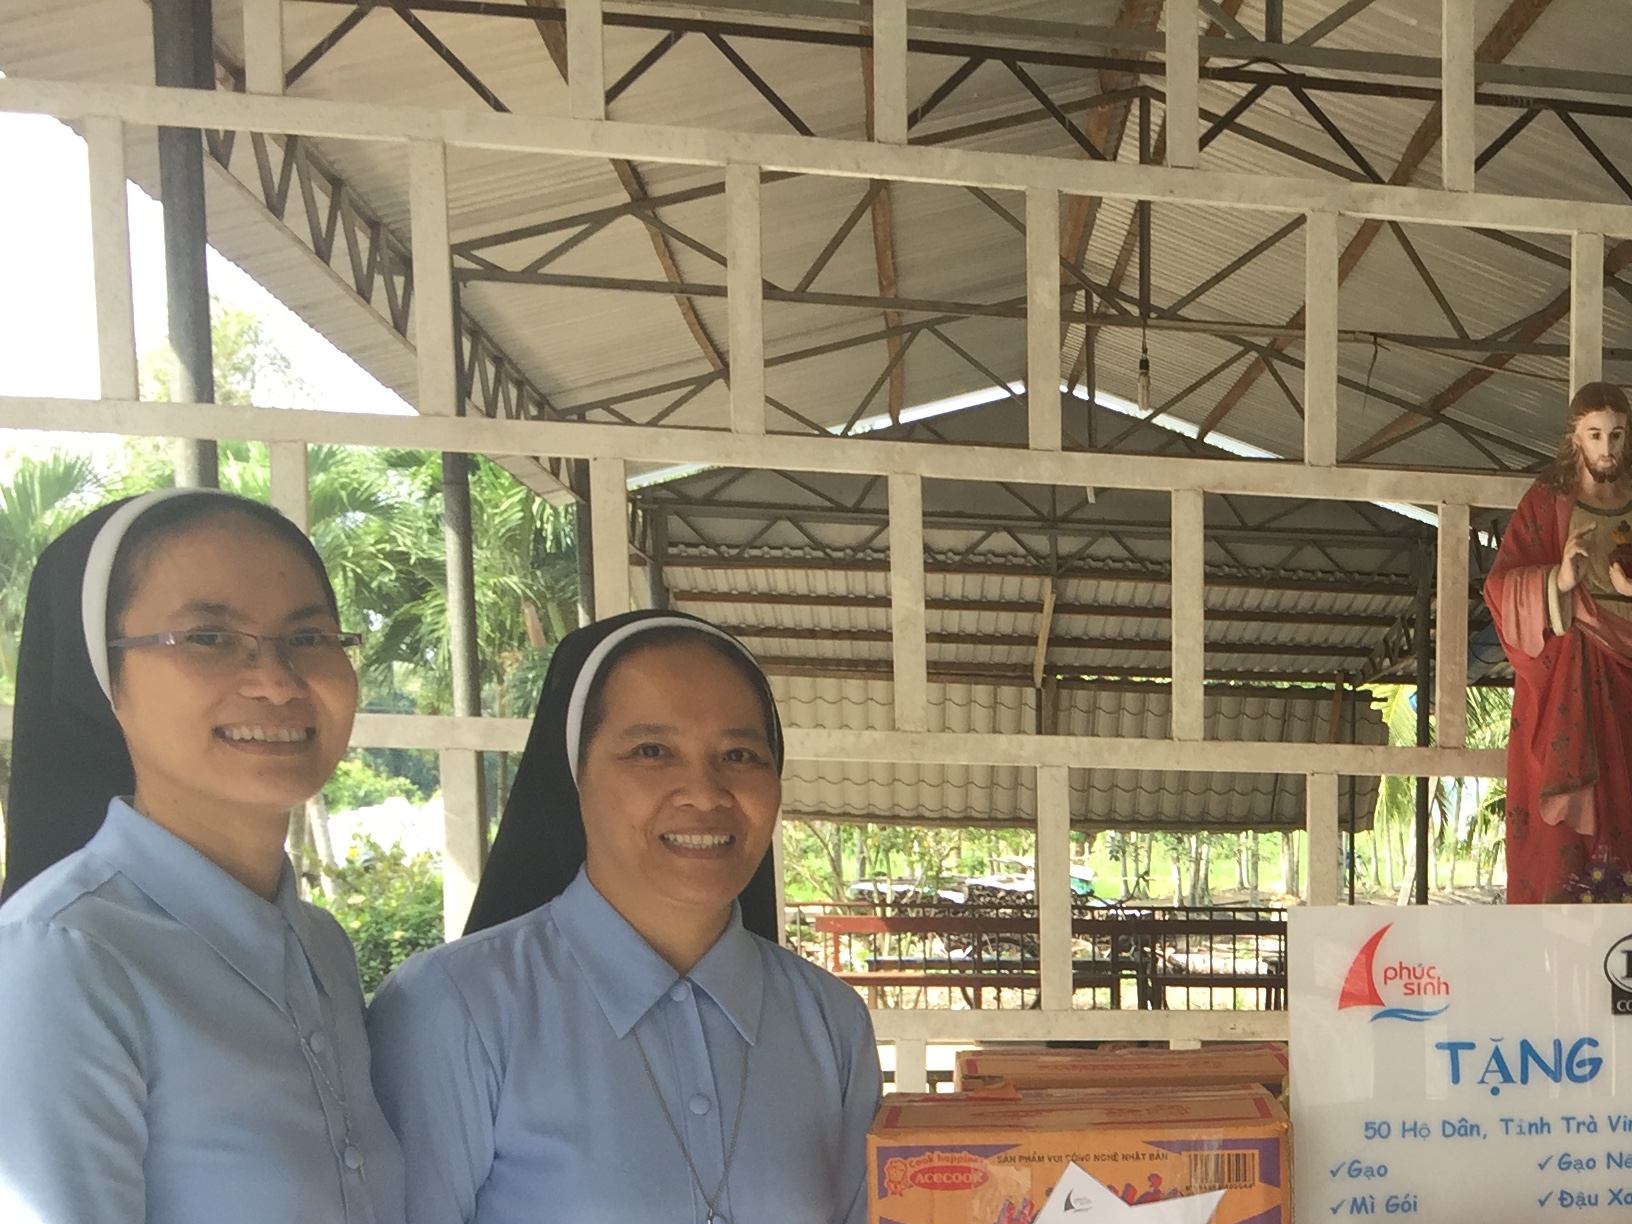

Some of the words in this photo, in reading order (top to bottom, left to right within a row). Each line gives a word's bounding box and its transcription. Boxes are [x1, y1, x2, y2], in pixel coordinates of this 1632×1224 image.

[1383, 961, 1437, 984] phúc
[1403, 978, 1450, 996] sinh
[1435, 1037, 1603, 1096] TẶNG
[1364, 1122, 1391, 1139] 50
[1401, 1122, 1430, 1140] Hộ
[1442, 1118, 1488, 1139] Dân,
[1561, 1116, 1598, 1134] Trà
[1347, 1161, 1388, 1179] Gạo
[1558, 1153, 1596, 1171] Gạo
[1350, 1196, 1375, 1214] Mì
[1386, 1195, 1418, 1213] Gói
[1559, 1190, 1598, 1208] Đậu
